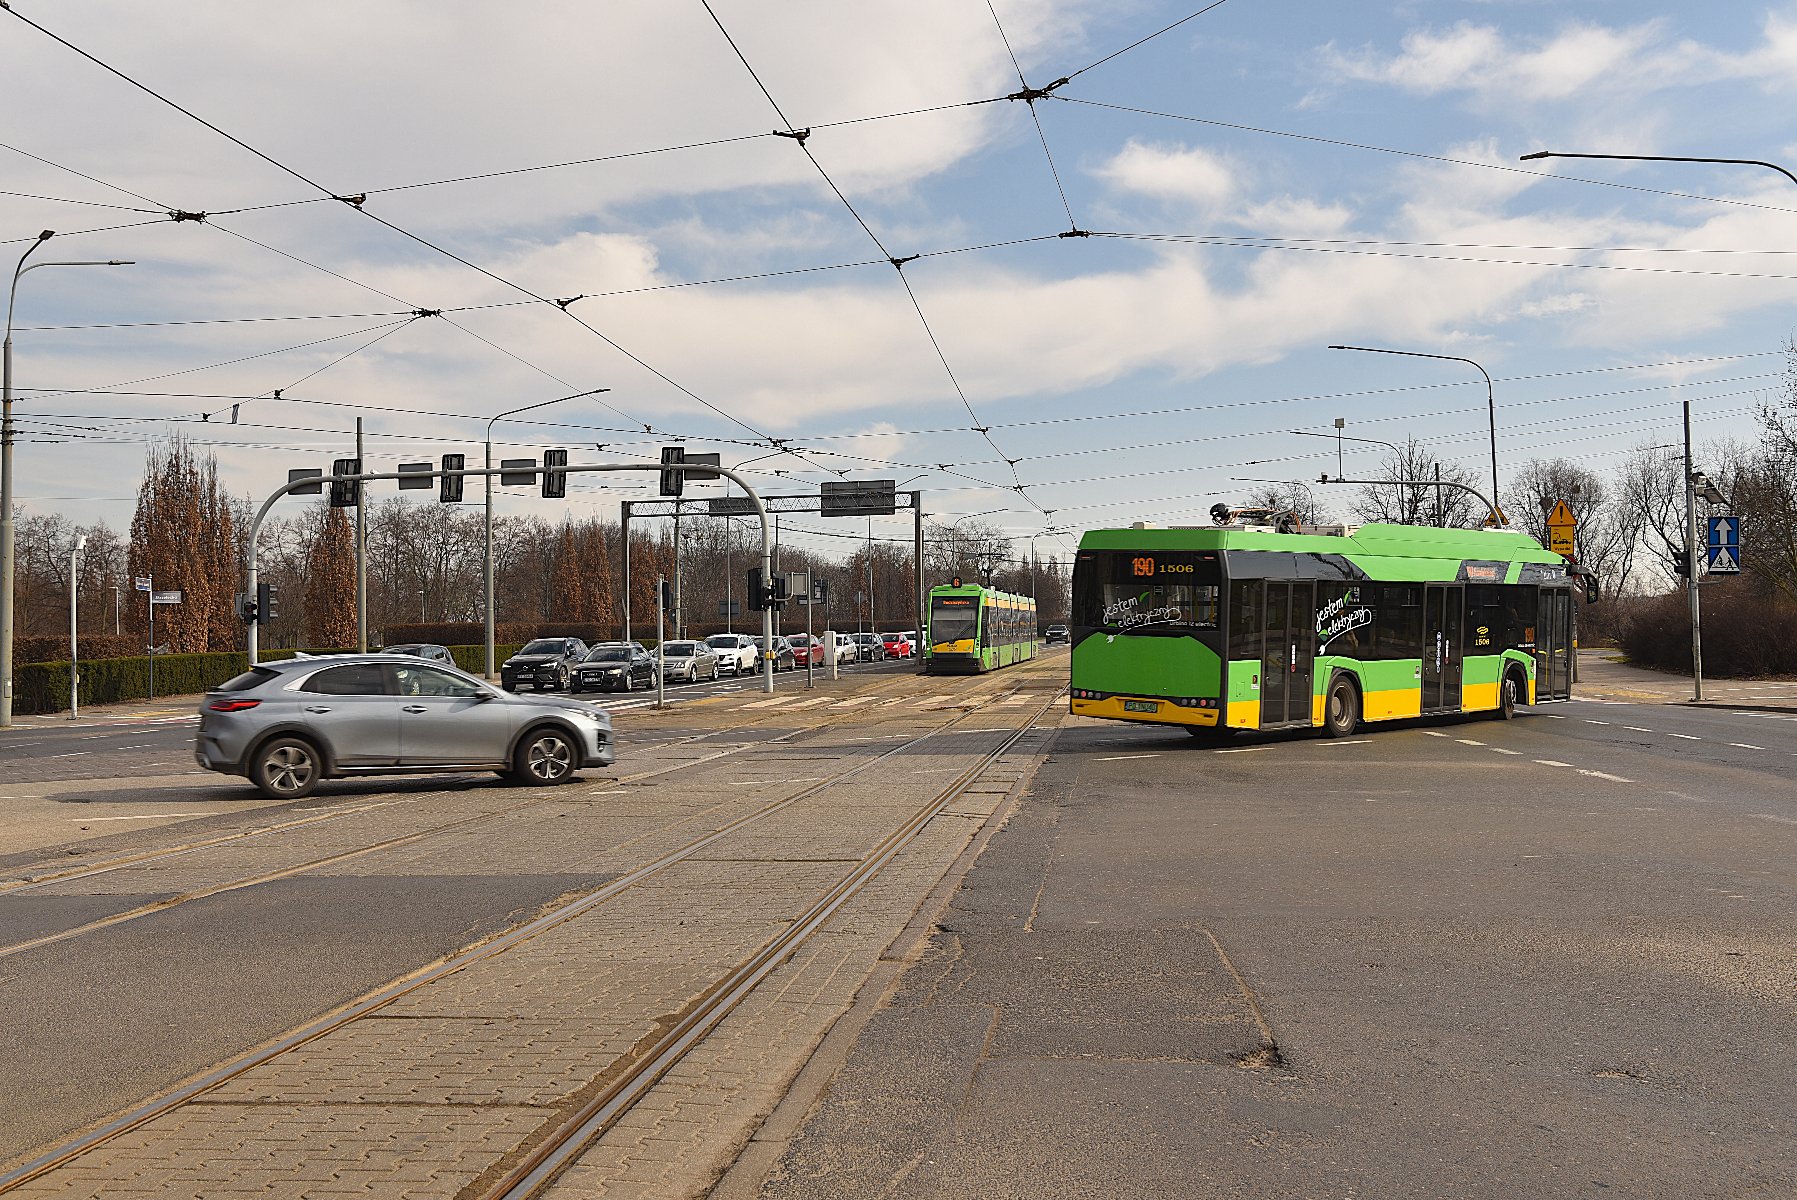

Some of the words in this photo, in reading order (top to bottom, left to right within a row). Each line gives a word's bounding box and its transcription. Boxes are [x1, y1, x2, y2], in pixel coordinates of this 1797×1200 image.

[1132, 557, 1155, 576] 190
[1159, 564, 1194, 573] 1506
[954, 578, 960, 586] 6
[1102, 596, 1138, 624] jestem
[1118, 604, 1171, 628] elektryczny
[1316, 597, 1344, 632] jestem
